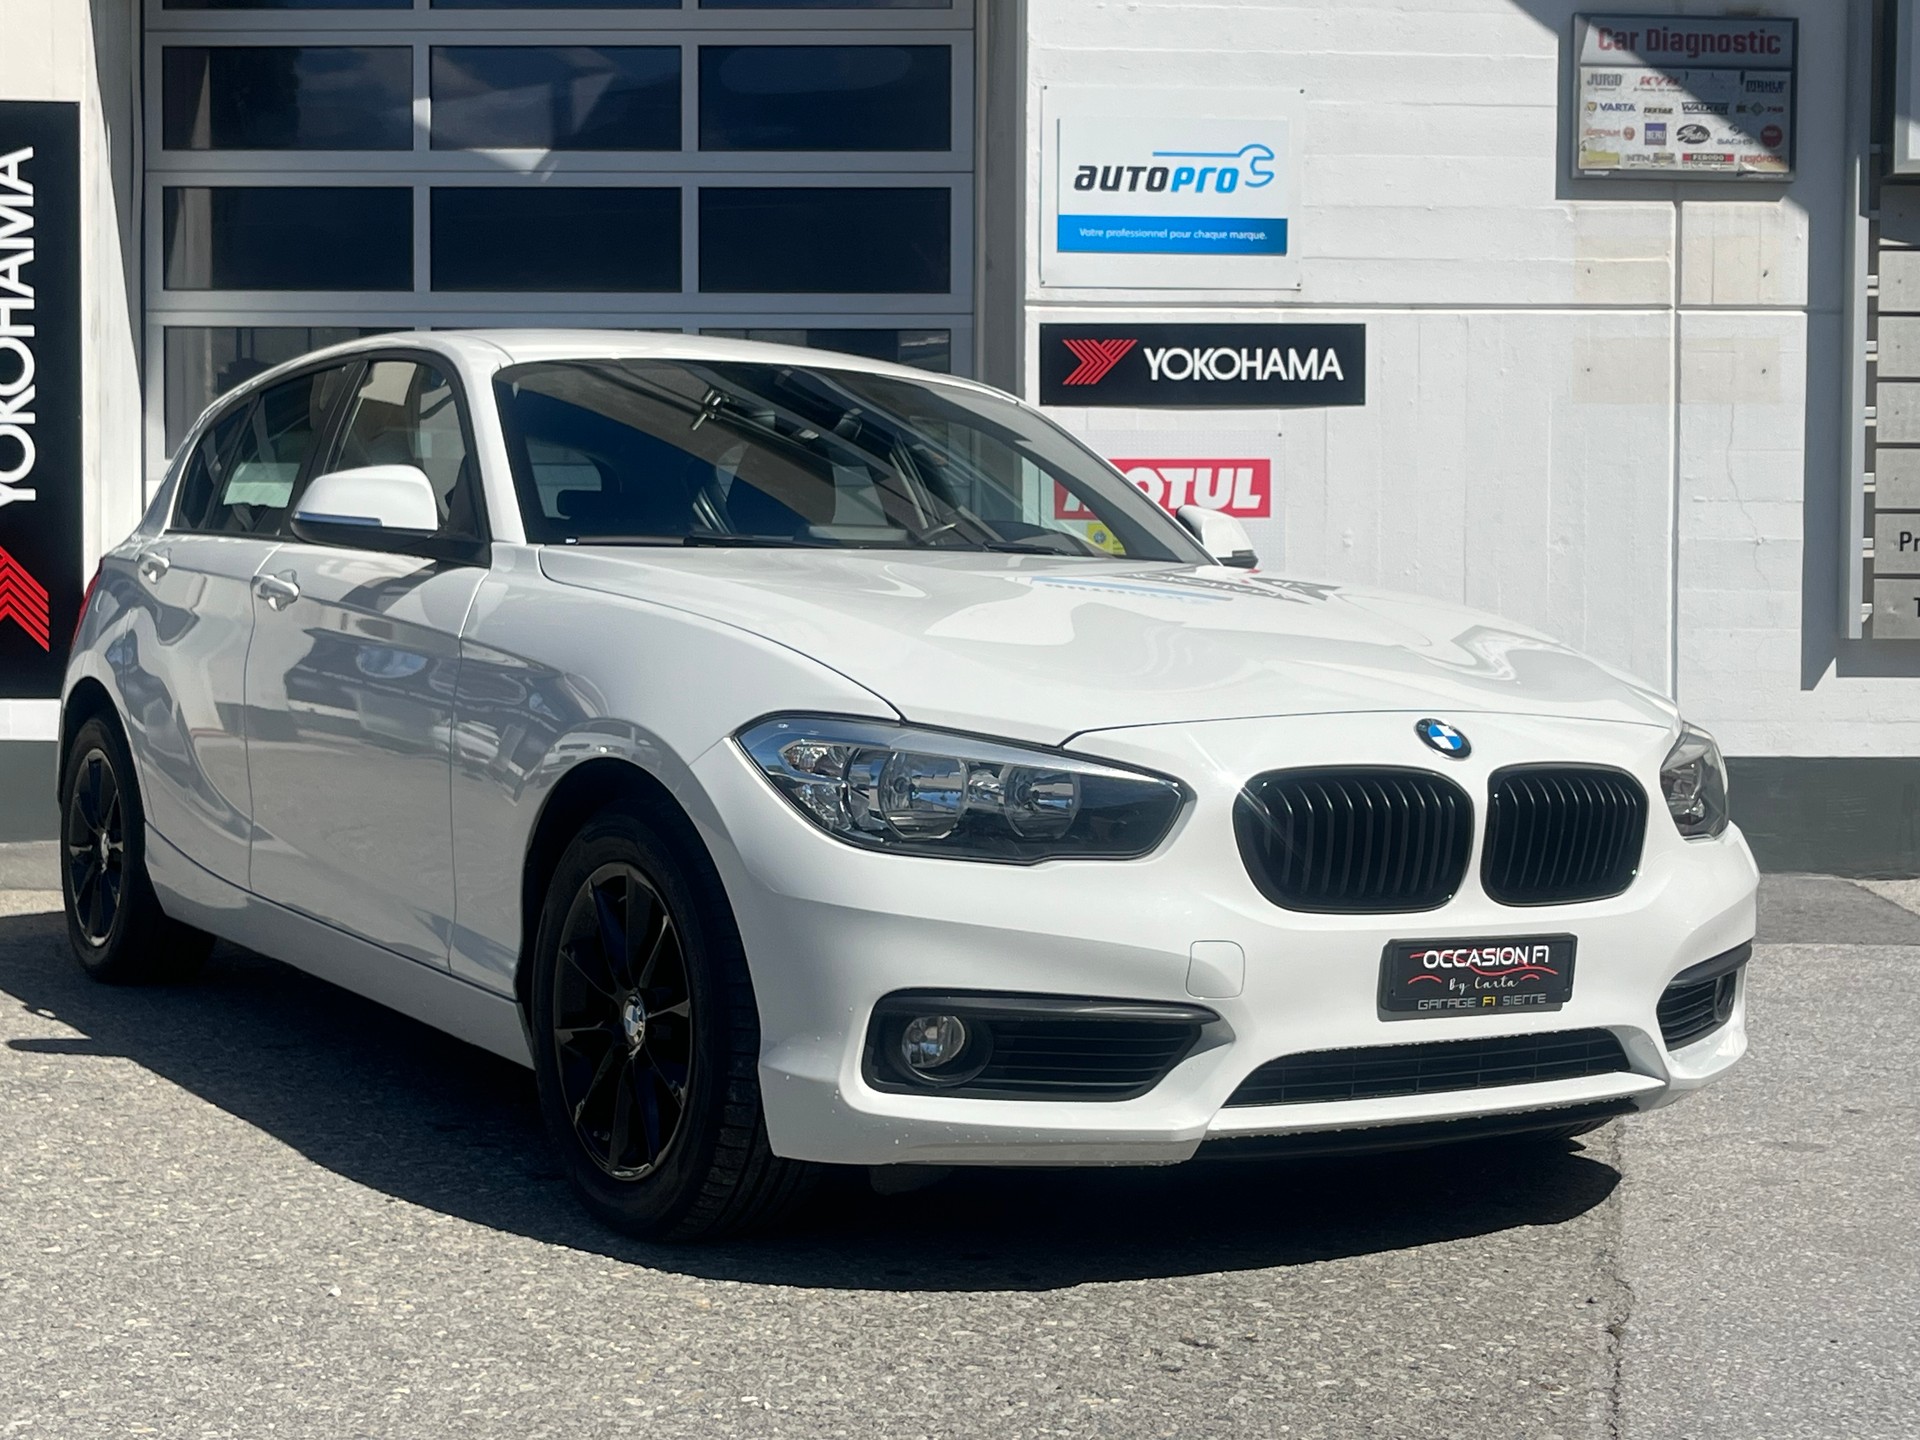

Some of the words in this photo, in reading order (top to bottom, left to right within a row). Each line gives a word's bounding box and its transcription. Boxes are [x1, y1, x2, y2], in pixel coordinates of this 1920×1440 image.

[1597, 27, 1639, 51] Car
[1646, 26, 1782, 58] Diagnostic
[1600, 103, 1637, 113] VARTA
[1079, 227, 1104, 238] Votre
[1105, 228, 1168, 240] professionnel
[1169, 230, 1192, 241] pour
[1193, 229, 1228, 241] chaque
[1229, 231, 1268, 242] marque.
[0, 146, 36, 507] YOKOHAMA
[1143, 348, 1344, 382] YOKOHAMA
[1423, 946, 1528, 969] OCCASION
[1532, 945, 1549, 964] F1
[1474, 975, 1520, 989] Carta
[1482, 996, 1496, 1007] F1
